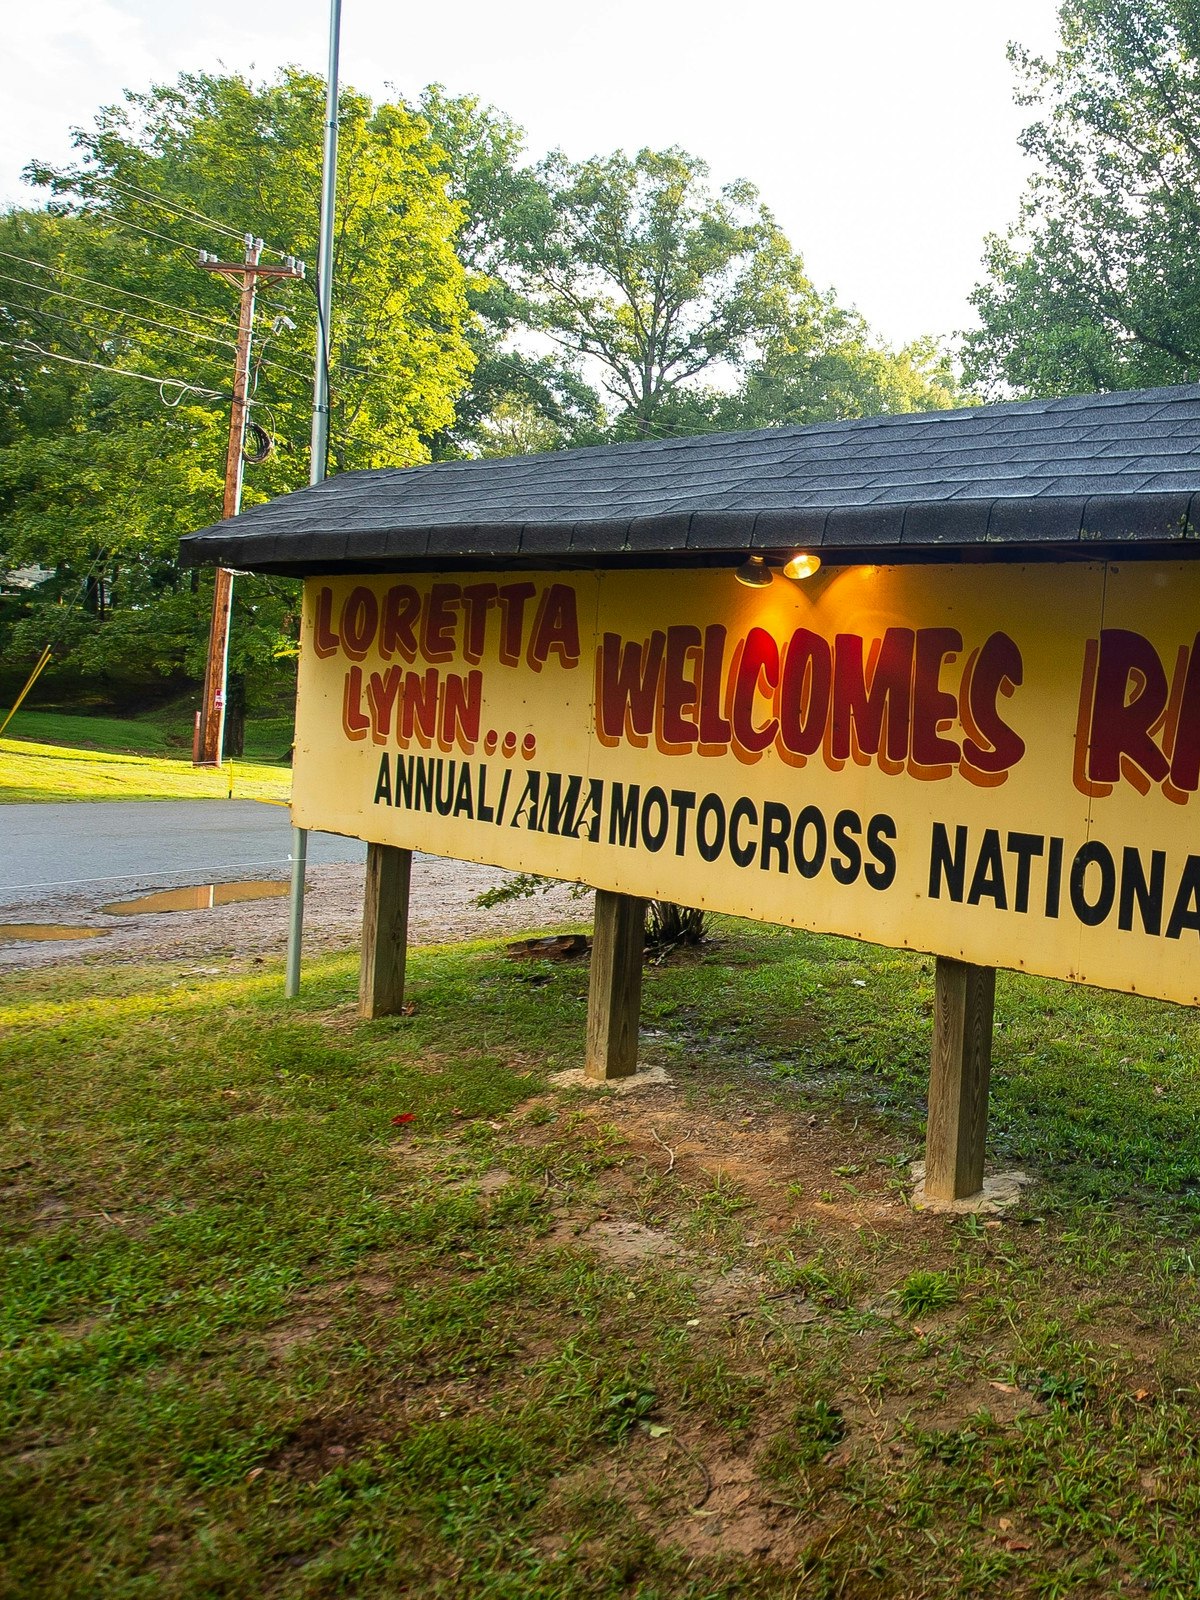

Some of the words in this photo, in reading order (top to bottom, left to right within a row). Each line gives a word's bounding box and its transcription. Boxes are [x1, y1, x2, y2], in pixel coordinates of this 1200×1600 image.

[313, 581, 582, 674] LORETTA
[594, 622, 1026, 789] WELCOMES
[608, 781, 898, 893] MOTOCROSS
